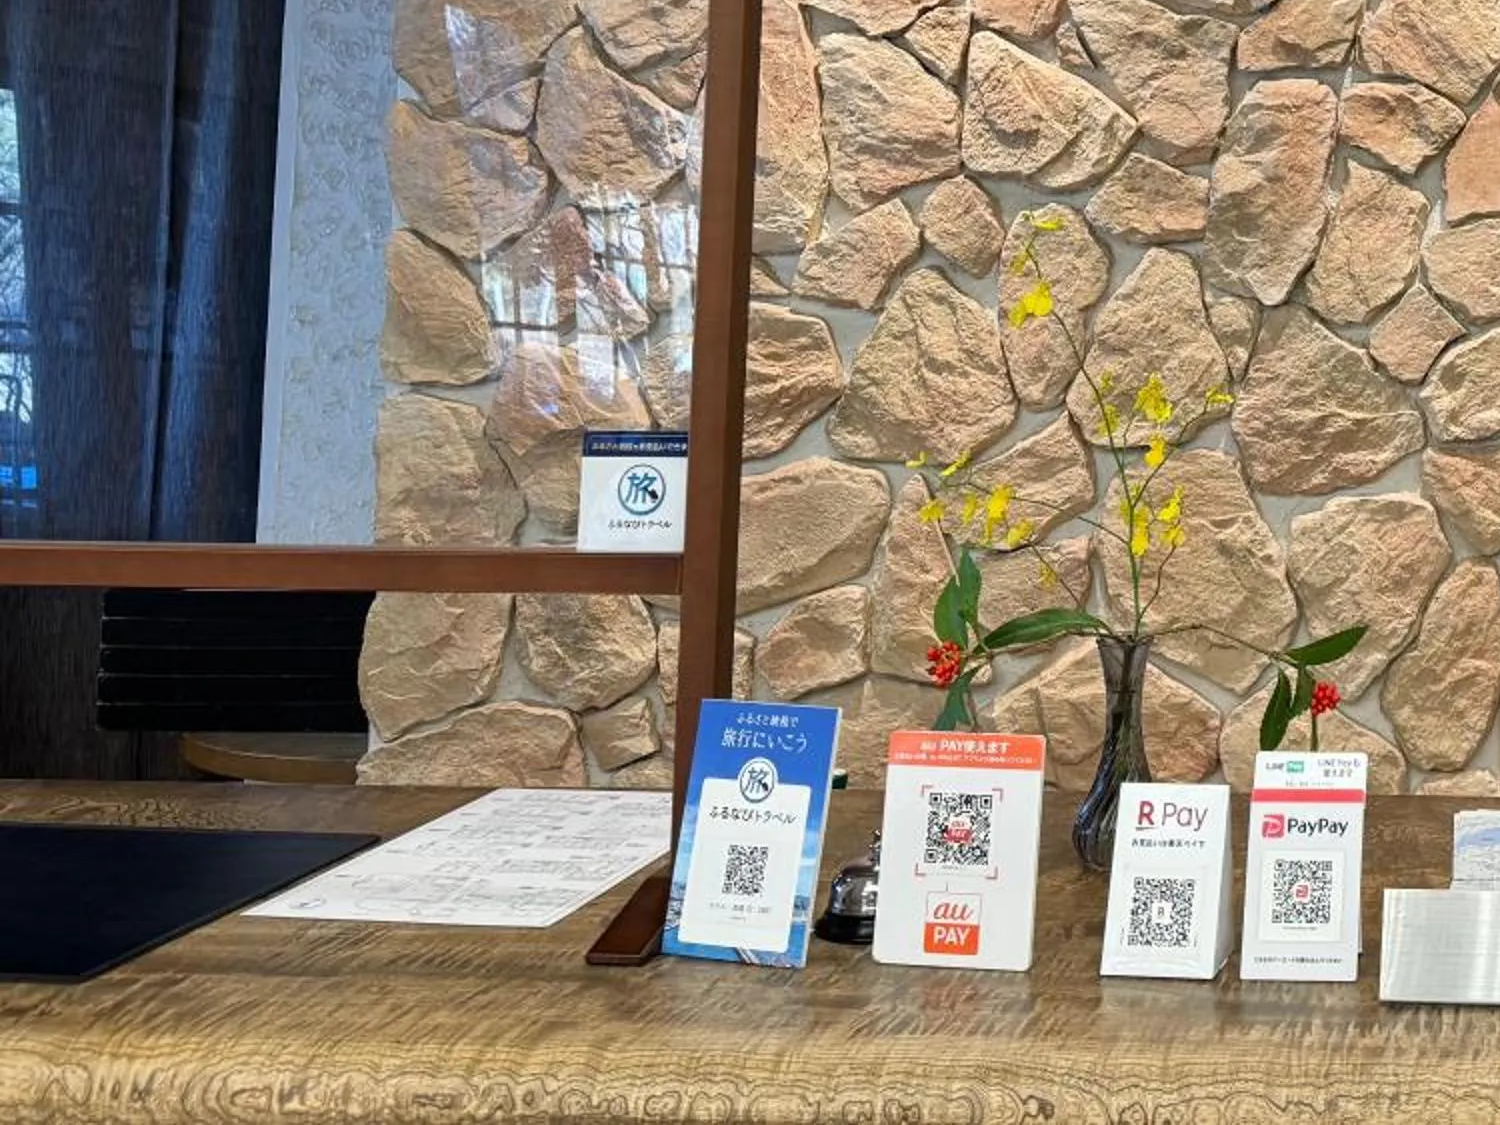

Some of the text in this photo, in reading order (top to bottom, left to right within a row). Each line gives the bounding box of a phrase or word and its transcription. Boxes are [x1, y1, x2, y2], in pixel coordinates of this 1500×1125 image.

[721, 727, 807, 753] 旅行にいこう
[708, 805, 797, 825] ふるなびトラベル
[1161, 802, 1209, 831] Pay
[1287, 817, 1349, 837] PayPay
[933, 900, 974, 921] au
[933, 925, 971, 947] PAY
